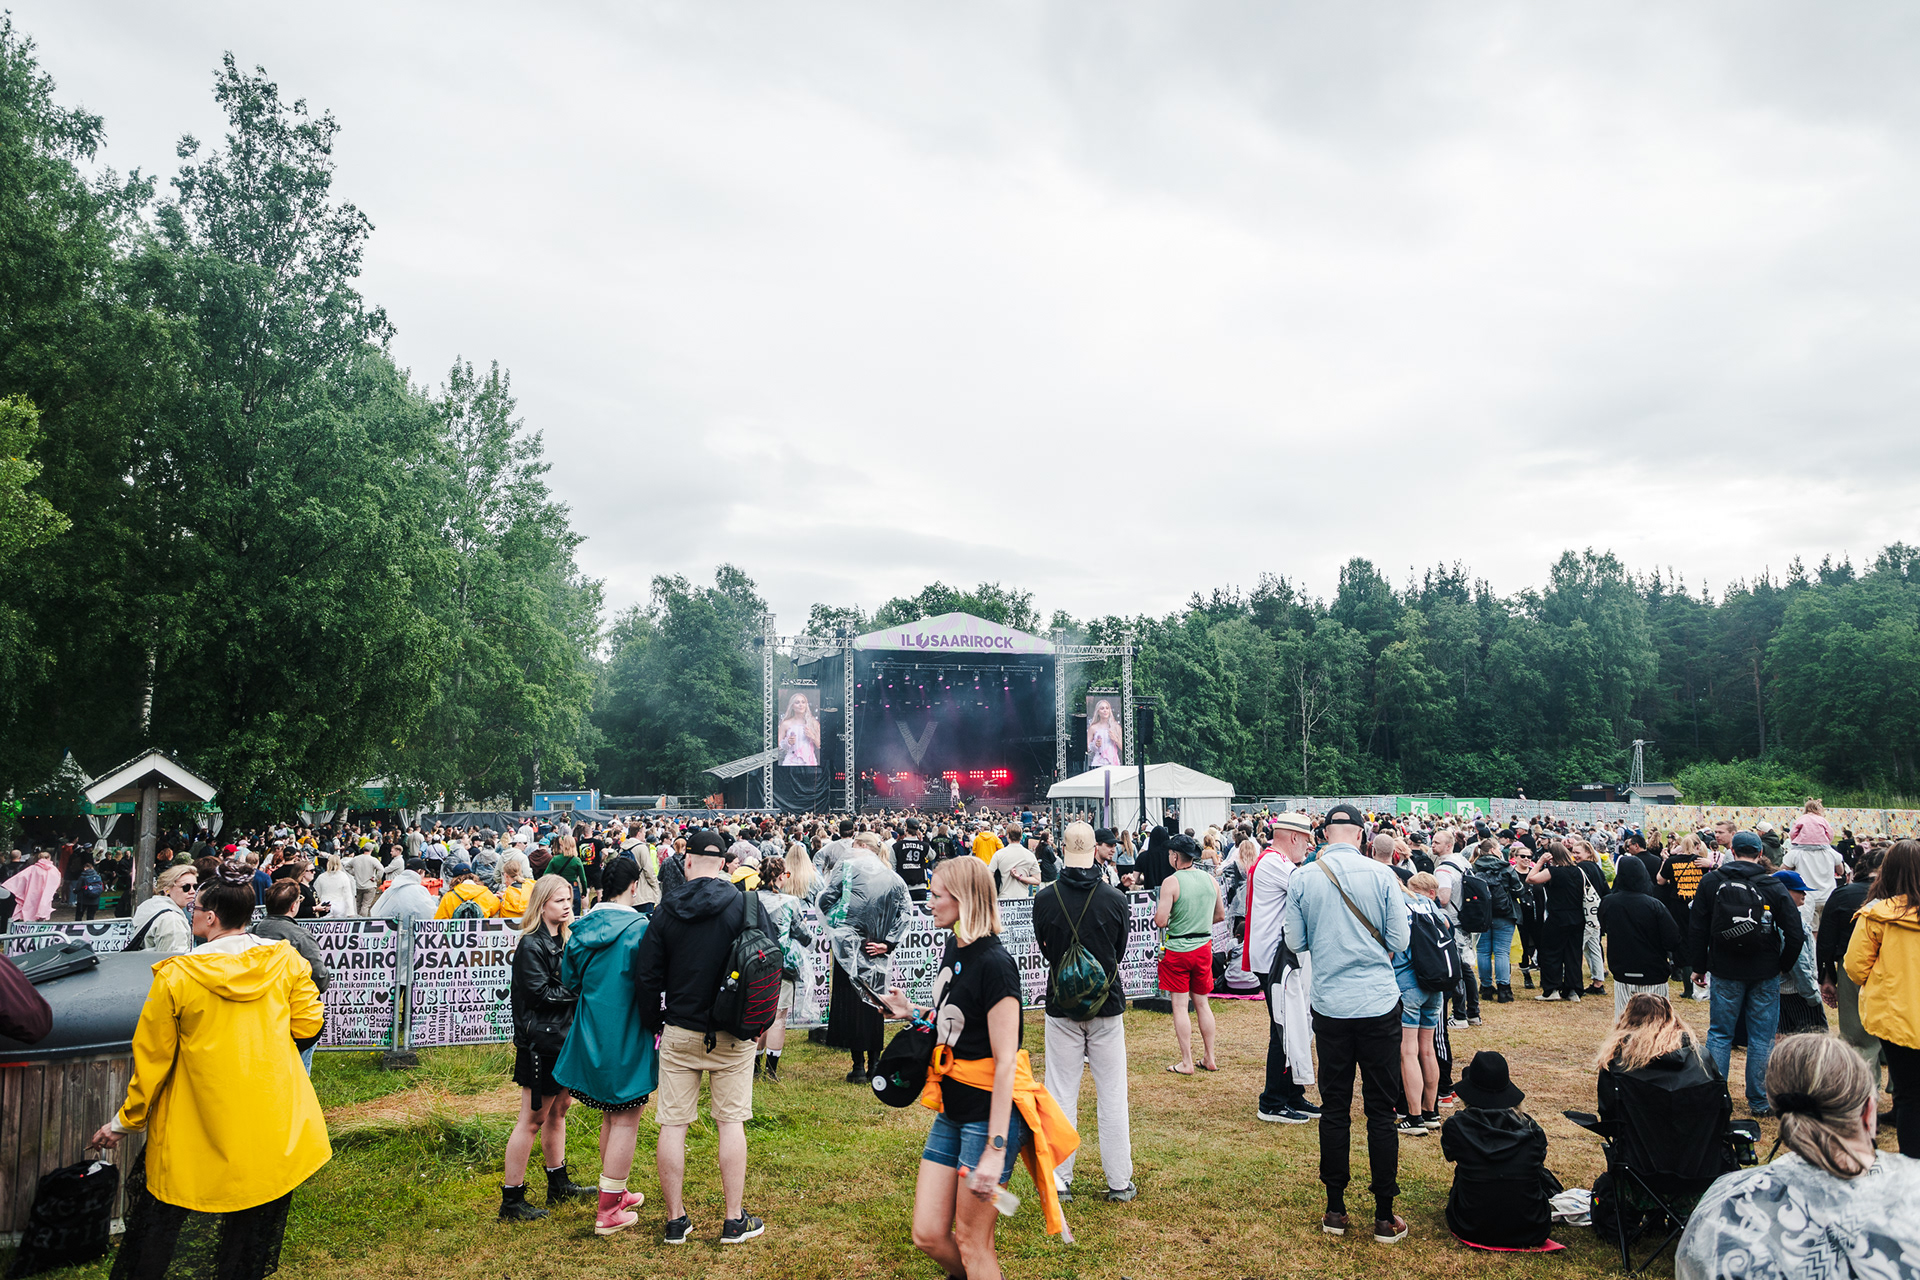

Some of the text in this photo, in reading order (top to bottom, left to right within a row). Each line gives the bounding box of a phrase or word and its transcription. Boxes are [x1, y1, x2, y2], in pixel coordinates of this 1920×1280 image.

[901, 633, 1014, 649] ILOSAARIROCK
[902, 843, 923, 851] ADIDAS
[906, 850, 920, 862] 49
[1129, 934, 1151, 943] since
[895, 949, 921, 959] since
[352, 971, 386, 981] since
[472, 969, 506, 979] since
[457, 979, 511, 987] heikommista
[428, 1015, 437, 1041] PUSU
[460, 1025, 487, 1036] Kaikki
[341, 1028, 366, 1039] Kaikki
